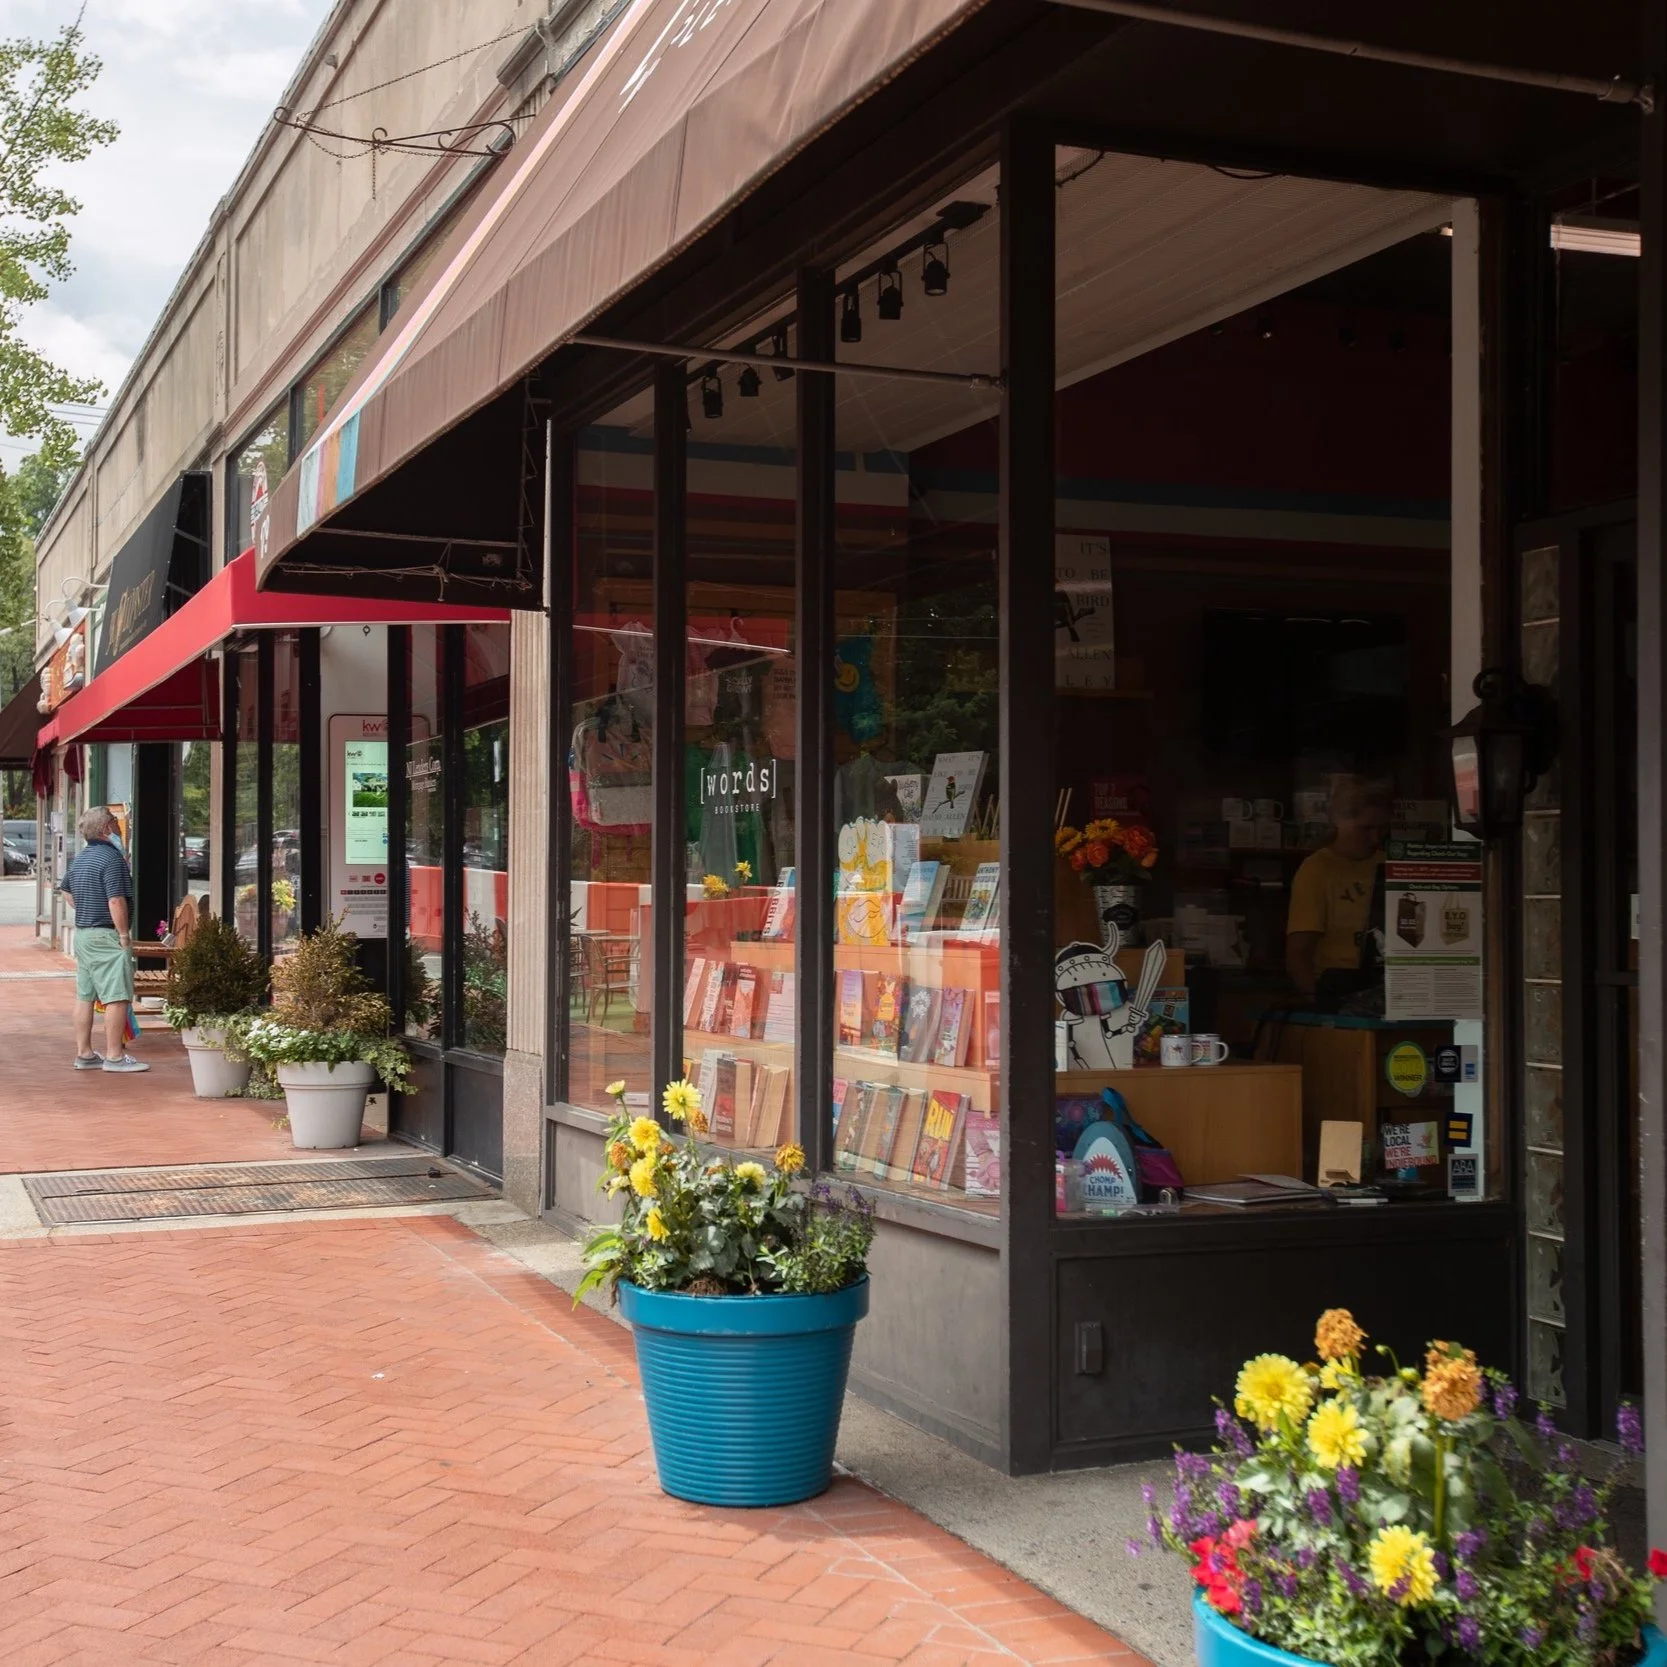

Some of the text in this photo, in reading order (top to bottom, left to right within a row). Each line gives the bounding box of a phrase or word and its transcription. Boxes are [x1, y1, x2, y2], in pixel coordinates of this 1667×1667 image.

[1080, 542, 1107, 556] IT'S
[1091, 569, 1109, 581] BE
[1076, 594, 1110, 608] BIRD
[714, 803, 760, 815] BOOKSTORE
[763, 880, 784, 934] RABBITS
[1393, 1074, 1423, 1083] WINNER
[925, 1098, 954, 1141] RUN
[1384, 1124, 1411, 1136] WE'RE
[1384, 1134, 1412, 1147] LOCAL
[1384, 1146, 1412, 1158] WE'RE
[1452, 1159, 1476, 1173] ABA
[1089, 1175, 1118, 1185] CHOMP
